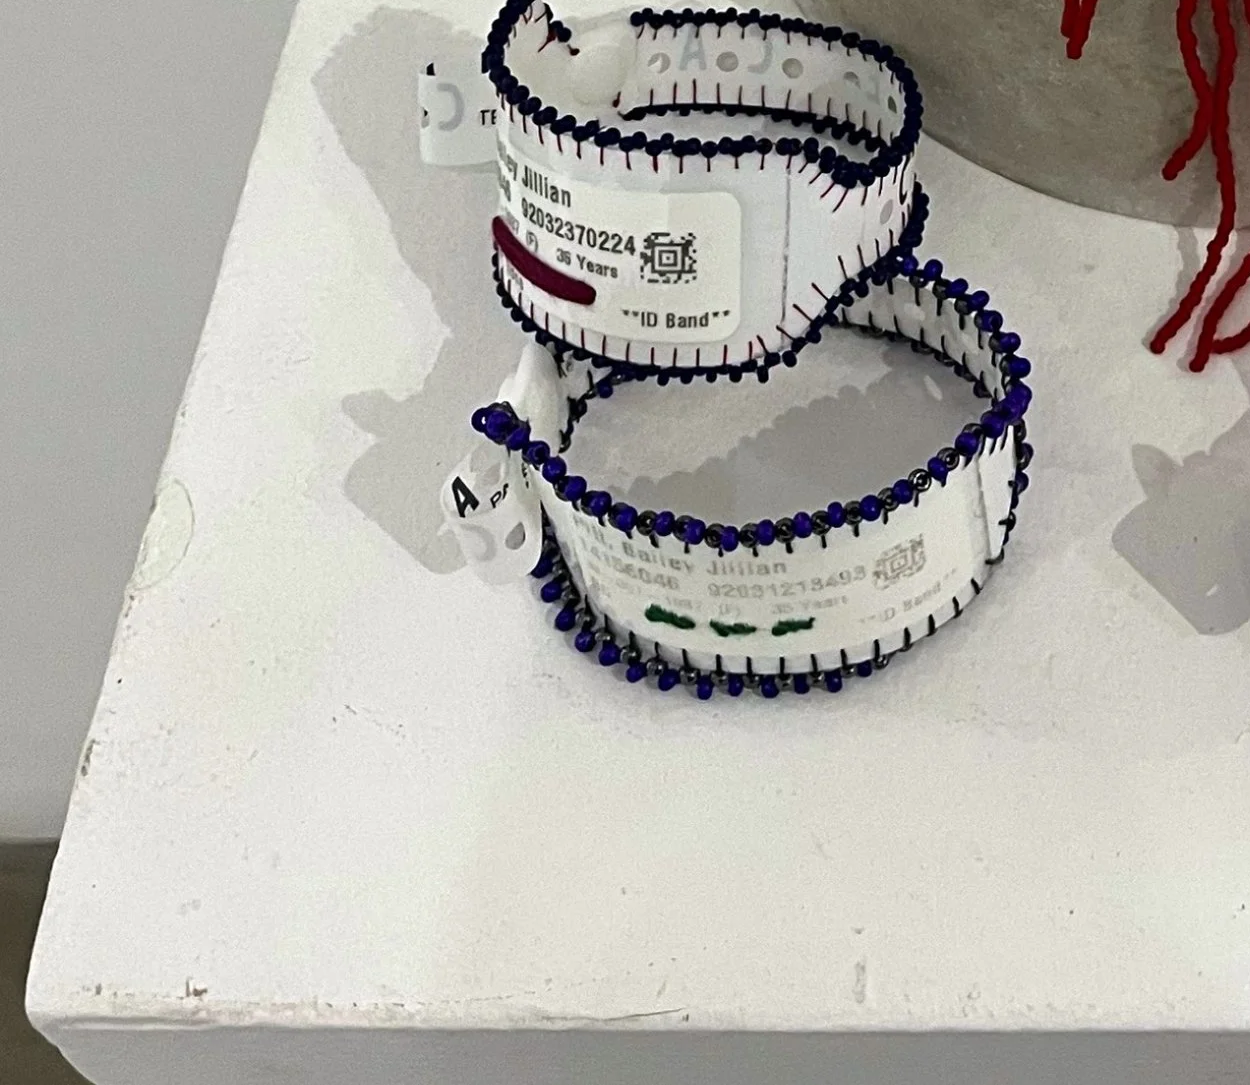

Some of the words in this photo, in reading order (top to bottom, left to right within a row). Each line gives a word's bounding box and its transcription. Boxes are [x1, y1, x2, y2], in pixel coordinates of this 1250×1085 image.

[521, 165, 572, 208] Jillian
[521, 197, 636, 256] 92032370224
[576, 254, 618, 278] Years
[707, 560, 787, 577] Jillian
